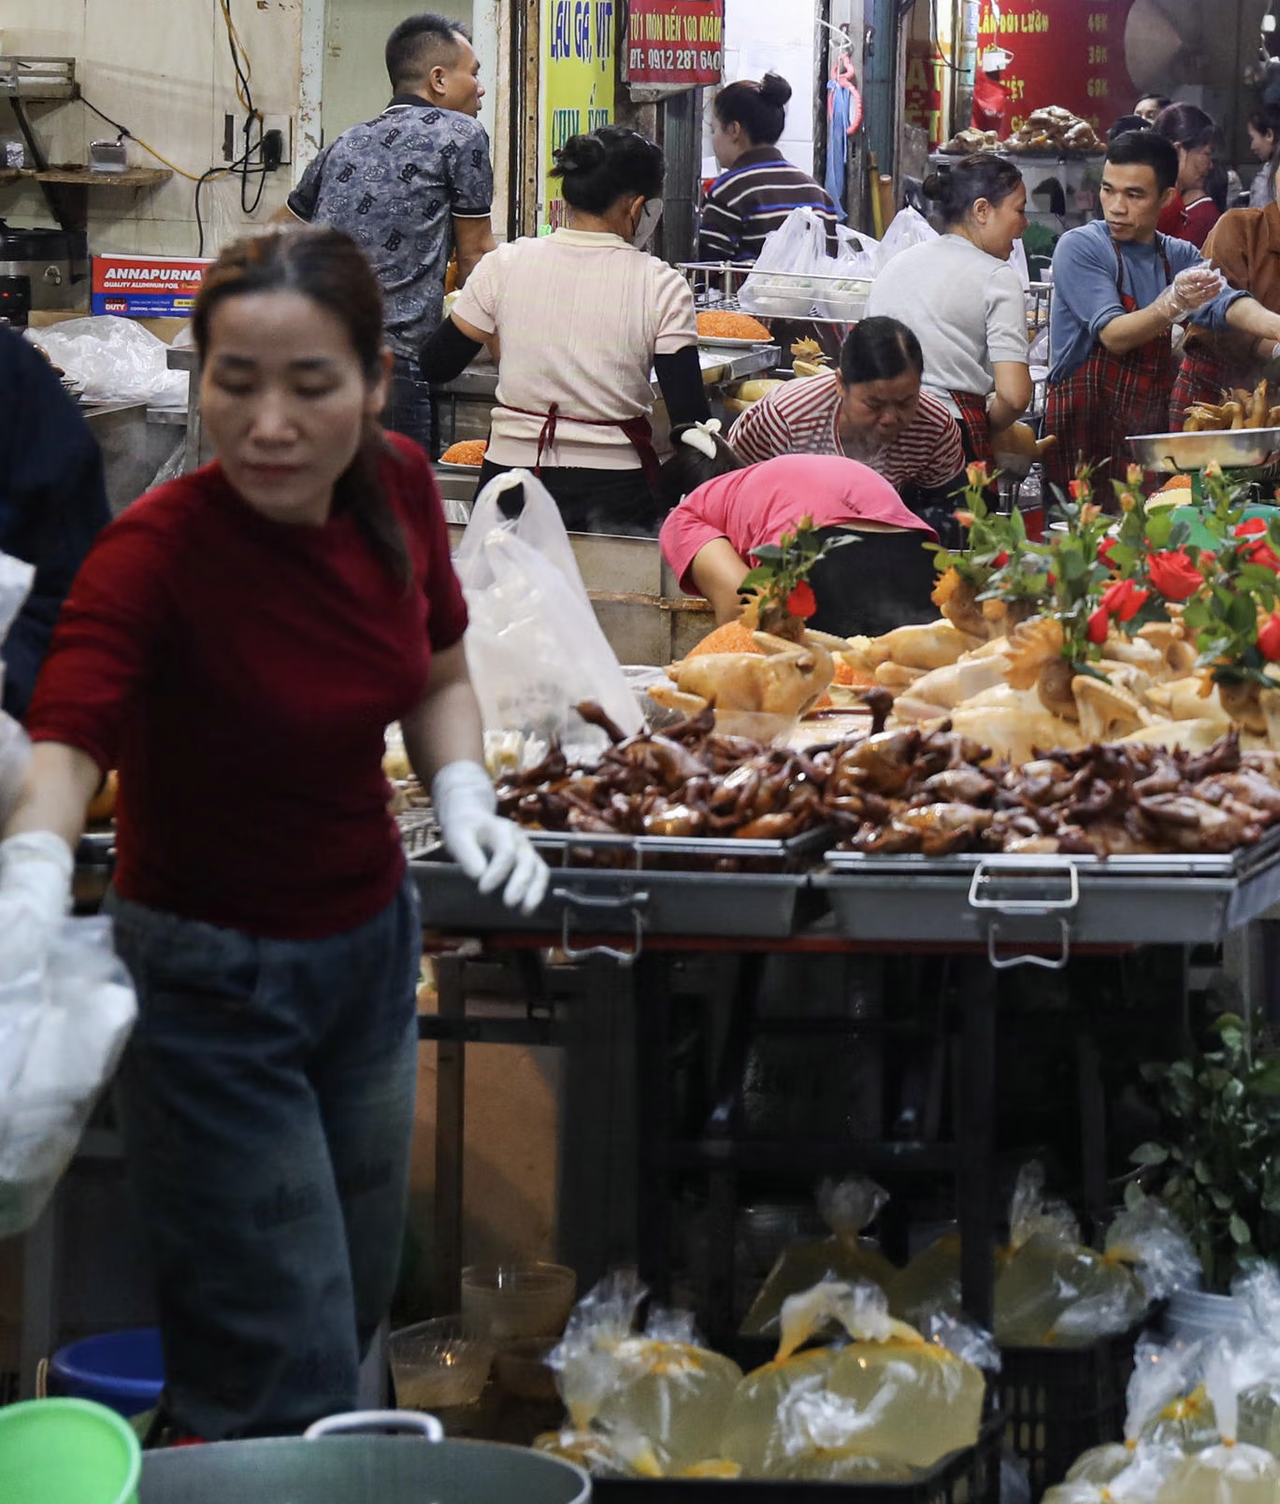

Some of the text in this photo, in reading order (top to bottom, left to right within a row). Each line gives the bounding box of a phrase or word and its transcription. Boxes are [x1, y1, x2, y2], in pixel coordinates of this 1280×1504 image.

[683, 15, 697, 42] 100
[648, 48, 674, 70] 0912
[676, 50, 697, 71] 287
[700, 50, 721, 71] 640
[105, 268, 202, 280] ANNAPURNA
[105, 303, 125, 311] DUTY
